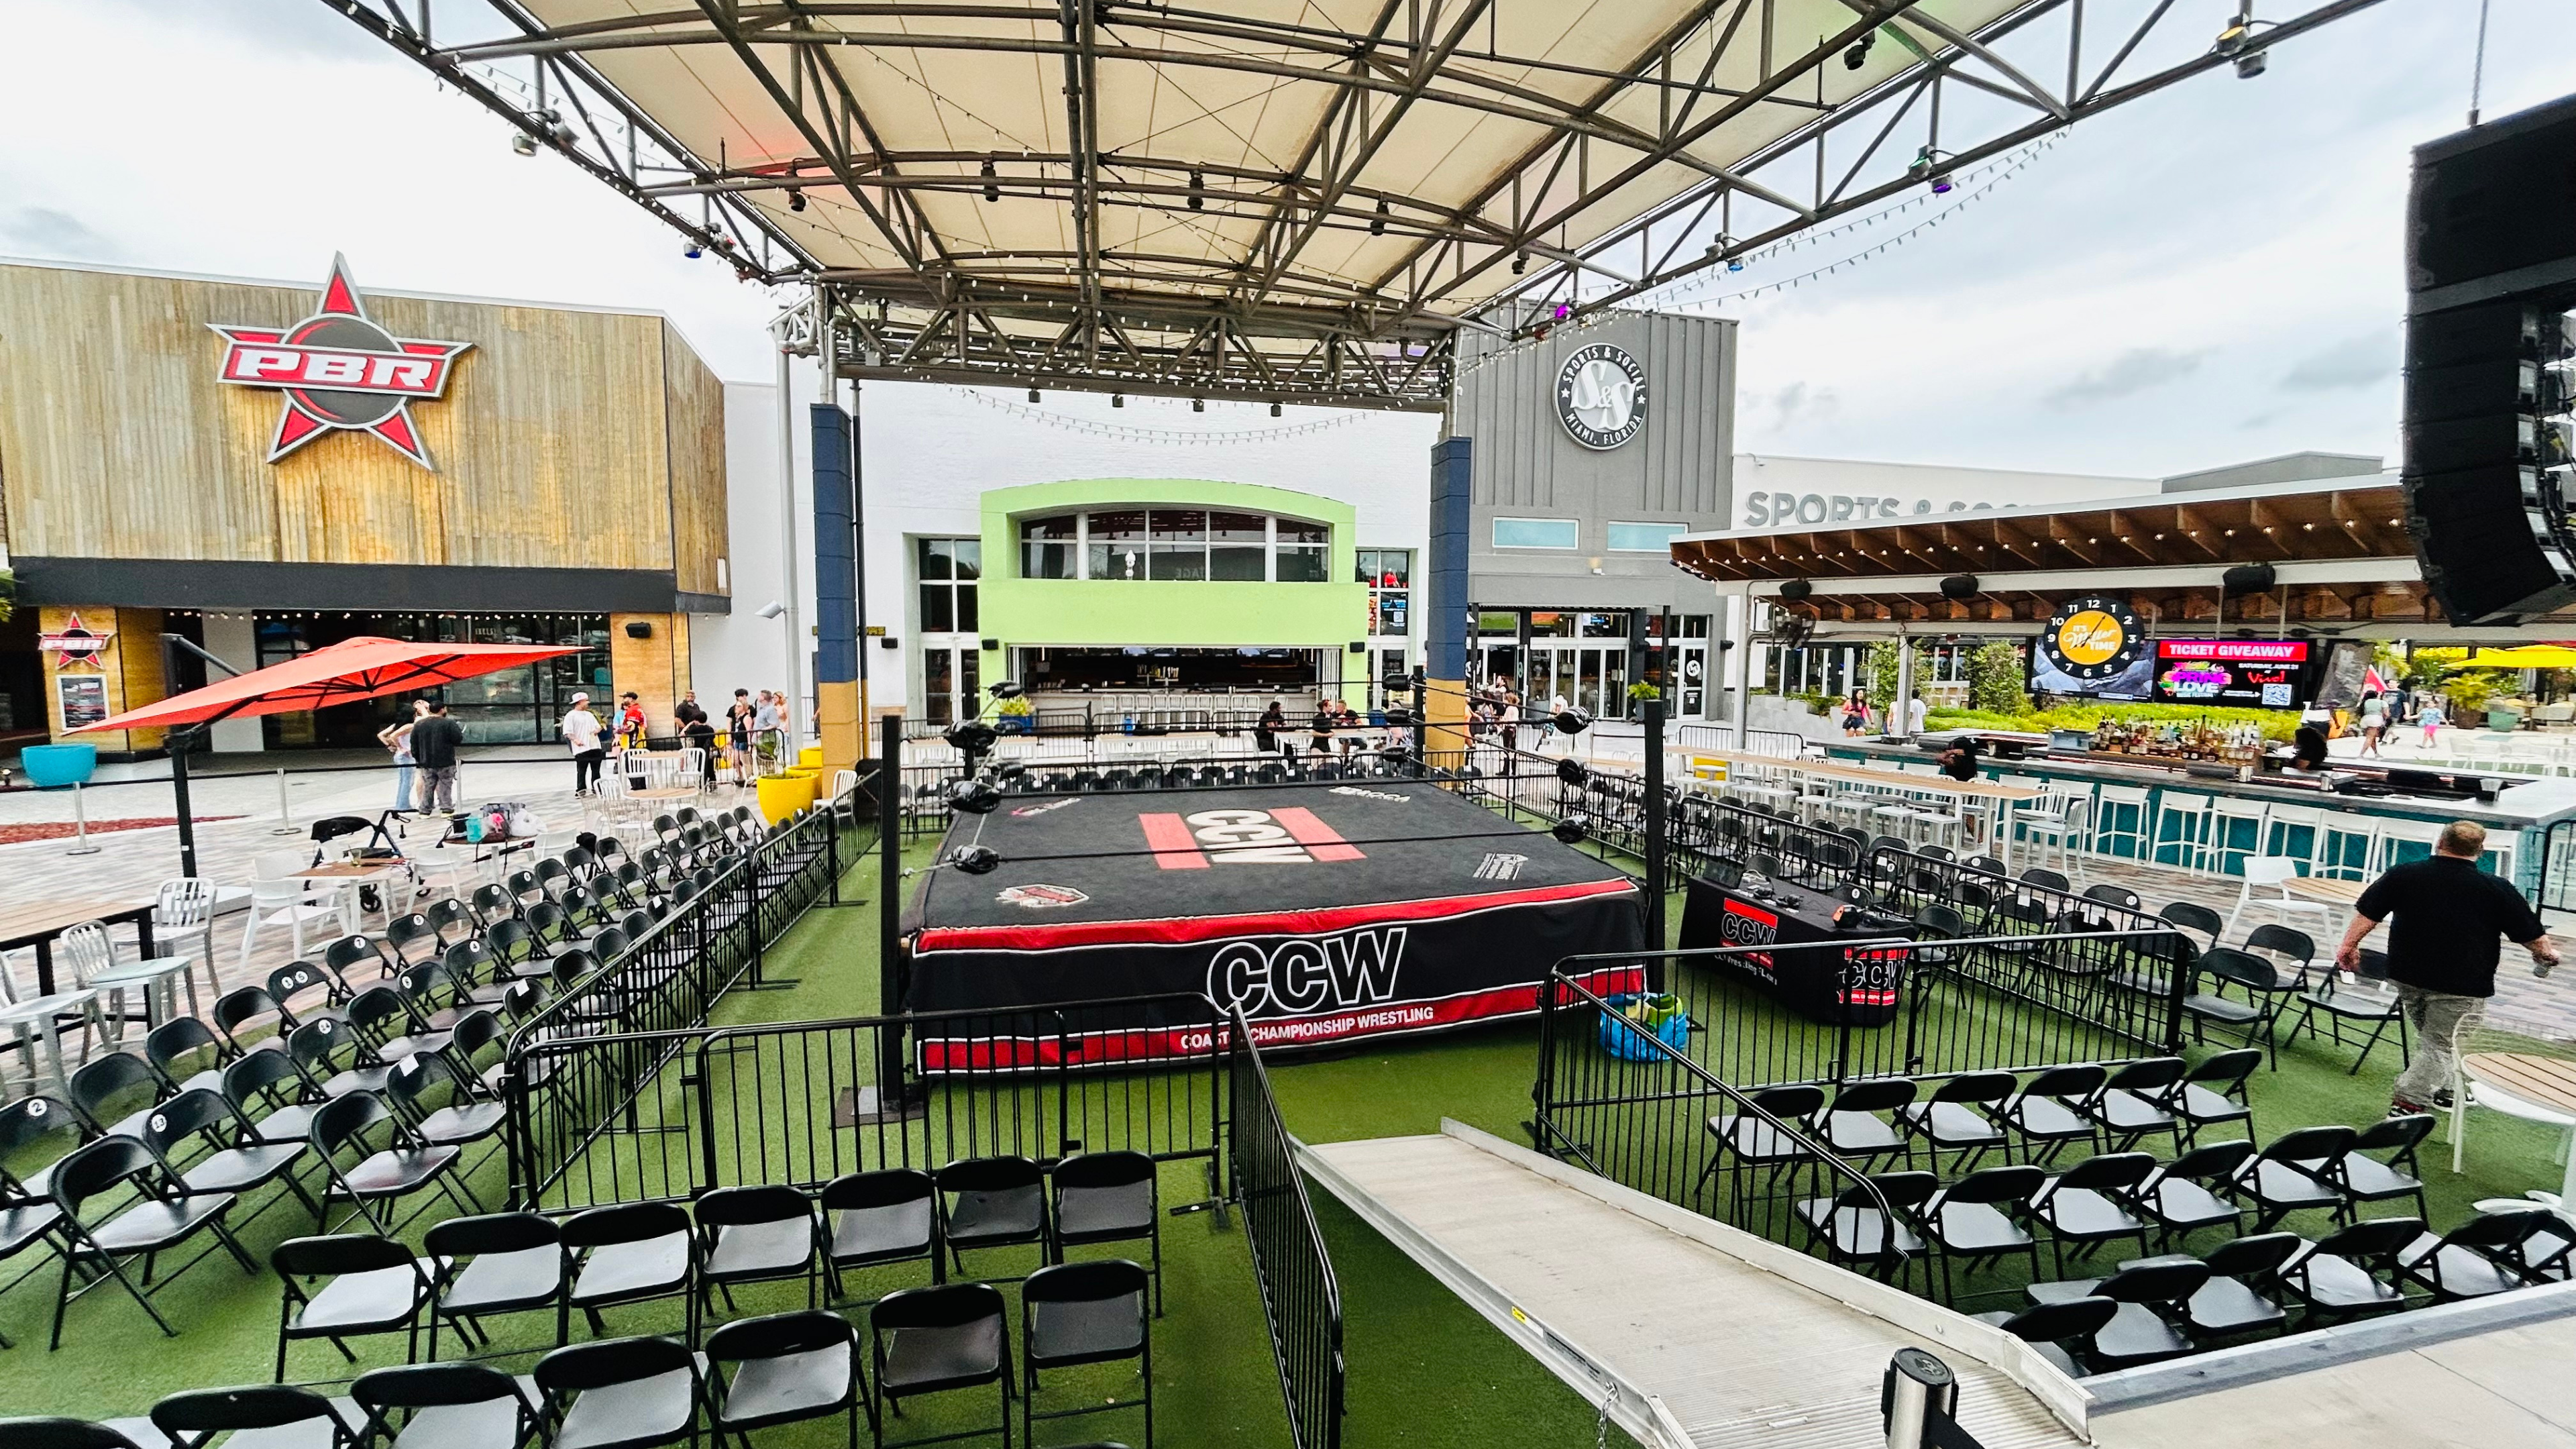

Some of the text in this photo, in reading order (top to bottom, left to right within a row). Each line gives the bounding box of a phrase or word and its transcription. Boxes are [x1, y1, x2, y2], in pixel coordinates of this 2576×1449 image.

[235, 348, 433, 389] PBR
[1562, 345, 1646, 392] SPORTS & SOCIAL
[1566, 412, 1642, 445] MIAMI, FLORIDA
[1744, 491, 1900, 527] SPORTS
[2068, 604, 2078, 613] 11
[2086, 599, 2100, 608] 12
[2110, 604, 2116, 613] 1
[2051, 617, 2065, 626] 10
[2123, 615, 2133, 625] 2
[2047, 633, 2056, 642] 9
[2127, 634, 2137, 643] 3
[42, 639, 103, 649] PBR
[2090, 641, 2116, 651] TIME
[2051, 650, 2059, 659] 8
[2120, 651, 2130, 660] 4
[2169, 644, 2295, 657] TICKET GIVEAWAY
[2065, 663, 2074, 672] 7
[2083, 668, 2092, 677] 6
[2103, 664, 2112, 674] 5
[2163, 671, 2233, 685] SPRING
[2174, 682, 2219, 693] LOVE
[1187, 809, 1314, 863] CCW
[1721, 912, 1776, 946] CCW
[1206, 926, 1408, 1017] CCW
[298, 973, 305, 981] 5
[1181, 1006, 1434, 1049] COAT CHAMPIONSHIP WRESTLING
[33, 1102, 42, 1113] 2
[154, 1117, 164, 1130] 13
